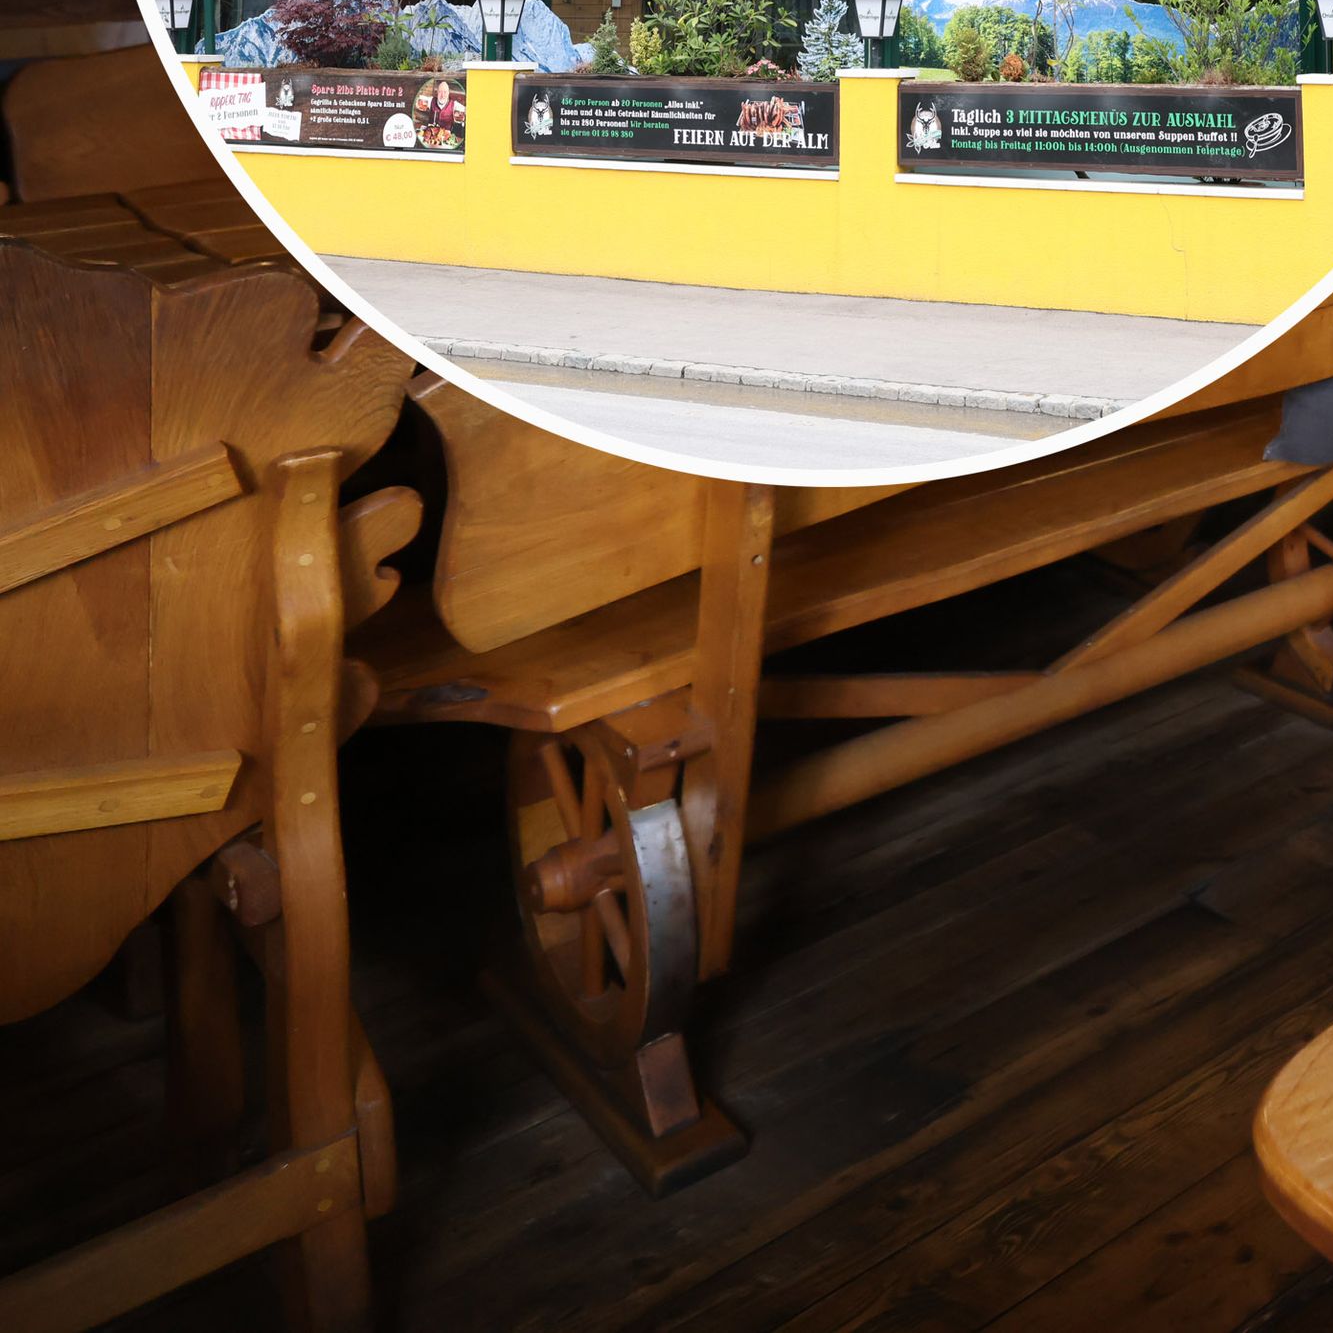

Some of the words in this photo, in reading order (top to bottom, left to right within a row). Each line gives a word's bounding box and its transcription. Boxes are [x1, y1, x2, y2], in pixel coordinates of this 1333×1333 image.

[311, 84, 335, 96] Spare
[336, 85, 354, 95] Ribs
[355, 86, 379, 96] Platte
[381, 86, 396, 96] für
[397, 87, 404, 97] 2
[574, 99, 586, 108] pro
[587, 98, 610, 107] Person
[611, 99, 620, 107] ab
[621, 99, 630, 107] 20
[632, 99, 663, 108] Personen
[560, 108, 578, 116] Essen
[580, 108, 593, 117] und
[594, 108, 602, 117] 4h
[604, 109, 616, 117] alle
[618, 109, 650, 118] Getränke!
[651, 110, 703, 120] Räumlichkeiten
[704, 112, 716, 120] für
[951, 108, 1001, 126] Täglich
[1006, 109, 1014, 124] 3
[1018, 109, 1128, 127] MITTAGSMENÜS
[1132, 112, 1161, 127] ZUR
[1166, 112, 1236, 129] AUSWAHL
[560, 118, 570, 126] bis
[596, 119, 629, 128] Personen!
[630, 120, 642, 128] Wir
[643, 120, 670, 129] beraten
[560, 128, 570, 136] sie
[571, 130, 590, 138] gerne
[673, 128, 724, 145] FEIERN
[730, 130, 757, 147] AUF
[762, 131, 792, 148] DER
[796, 132, 829, 150] ALM
[973, 127, 1000, 138] Suppe
[1002, 129, 1013, 137] so
[1016, 127, 1032, 137] viel
[1034, 128, 1048, 137] sie
[1050, 128, 1091, 139] möchten
[1093, 131, 1111, 139] von
[1113, 132, 1156, 140] unserem
[1158, 130, 1195, 142] Suppen
[1197, 131, 1228, 142] Buffet
[1230, 132, 1238, 142] !!
[951, 139, 982, 150] Montag
[985, 139, 998, 149] bis
[1000, 140, 1032, 152] Freitag
[1034, 140, 1066, 151] 11:00h
[1068, 141, 1082, 151] bis
[1084, 142, 1118, 152] 14:00h
[1119, 142, 1193, 155] (Ausgenommen
[1195, 144, 1246, 157] Feiertage)
